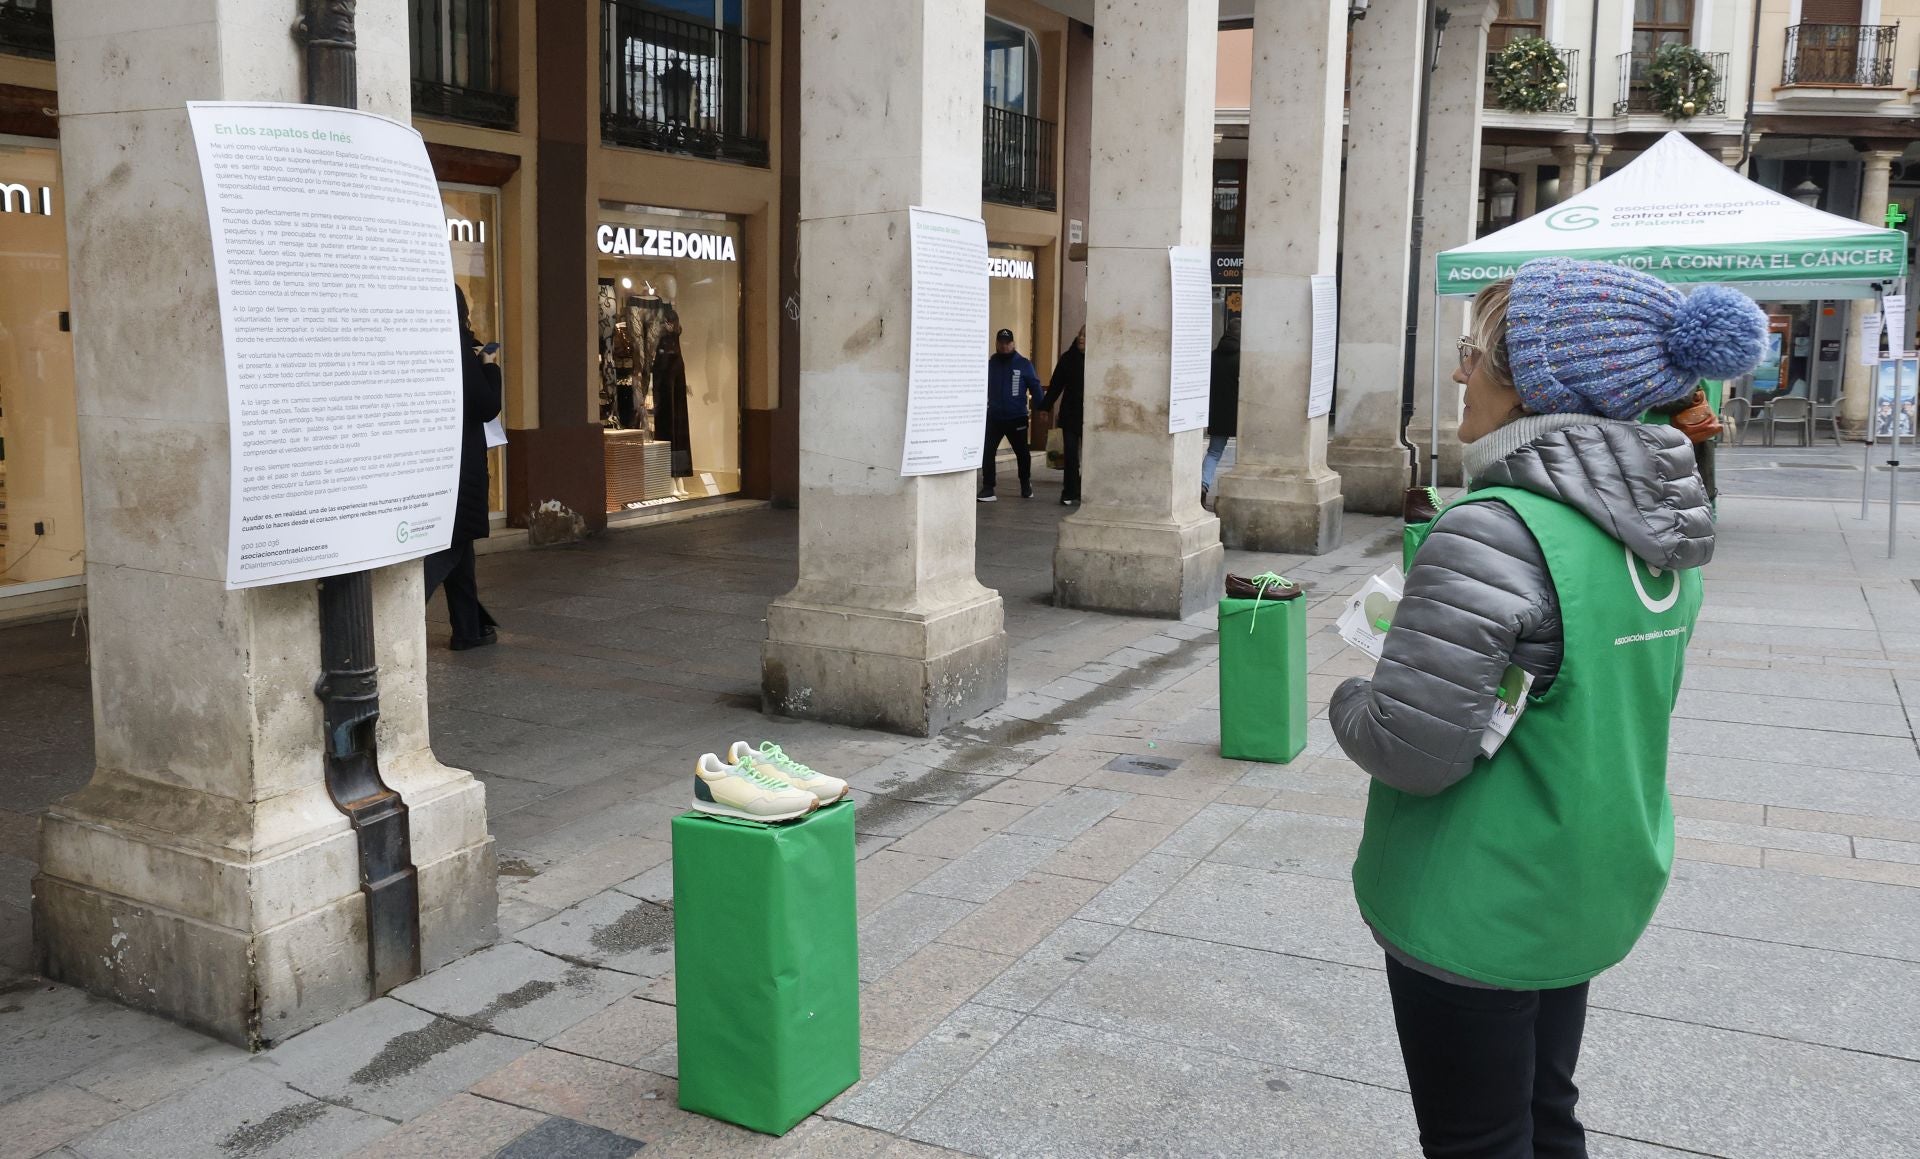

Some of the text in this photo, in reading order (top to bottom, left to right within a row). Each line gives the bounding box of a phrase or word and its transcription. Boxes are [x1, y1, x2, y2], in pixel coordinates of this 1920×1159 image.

[215, 124, 232, 135] En
[236, 124, 256, 135] los
[259, 128, 309, 139] zapatos
[312, 129, 327, 140] de
[1614, 199, 1781, 212] asociación española
[1612, 211, 1664, 220] contra
[1687, 208, 1745, 217] cáncer
[1635, 218, 1705, 226] Palencia
[597, 224, 736, 261] CALZEDONIA
[1607, 254, 1672, 270] ÑOLA
[1678, 254, 1764, 269] CONTRA
[1770, 254, 1796, 269] EL
[1800, 248, 1894, 268] CÁNCER
